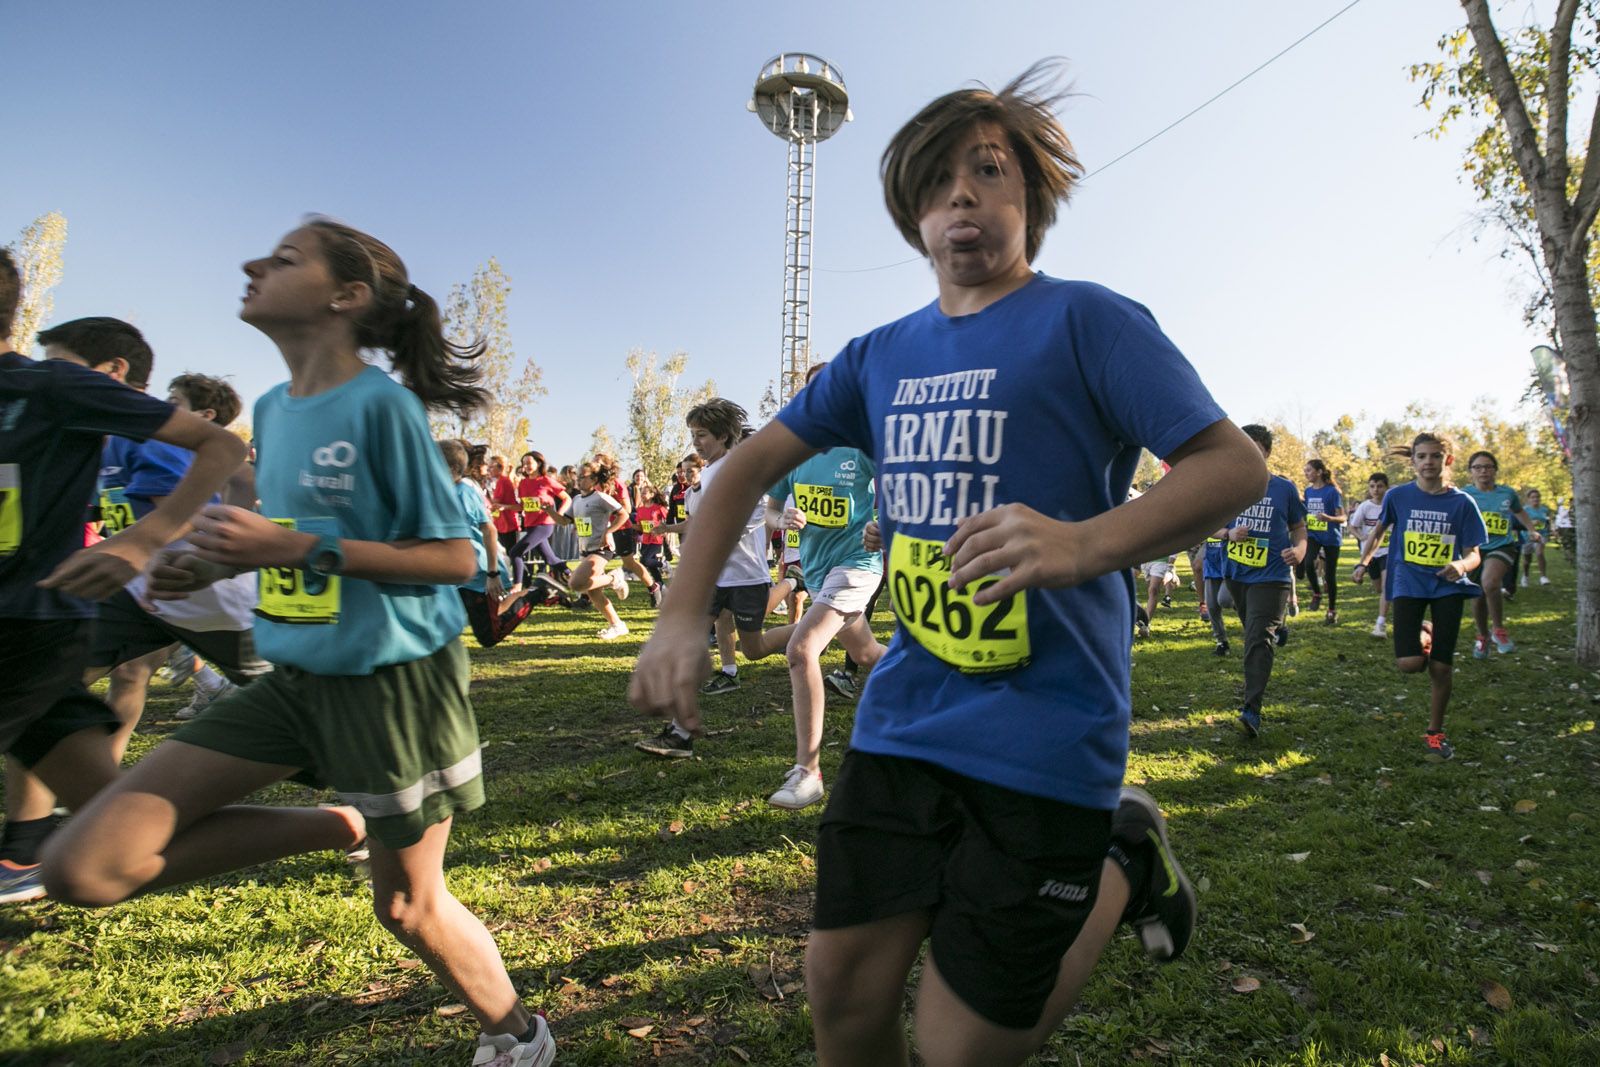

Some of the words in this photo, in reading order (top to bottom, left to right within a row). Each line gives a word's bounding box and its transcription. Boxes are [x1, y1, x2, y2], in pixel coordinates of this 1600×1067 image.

[892, 369, 997, 405] INSTITUT
[883, 409, 1008, 465] ARNAU
[799, 495, 846, 518] 3405
[1241, 506, 1273, 519] RNAU
[1410, 509, 1449, 521] INSTITUT
[1407, 519, 1451, 534] ARNAU
[1229, 540, 1266, 560] 2197
[1407, 540, 1450, 559] 0274
[895, 569, 1017, 640] 0262
